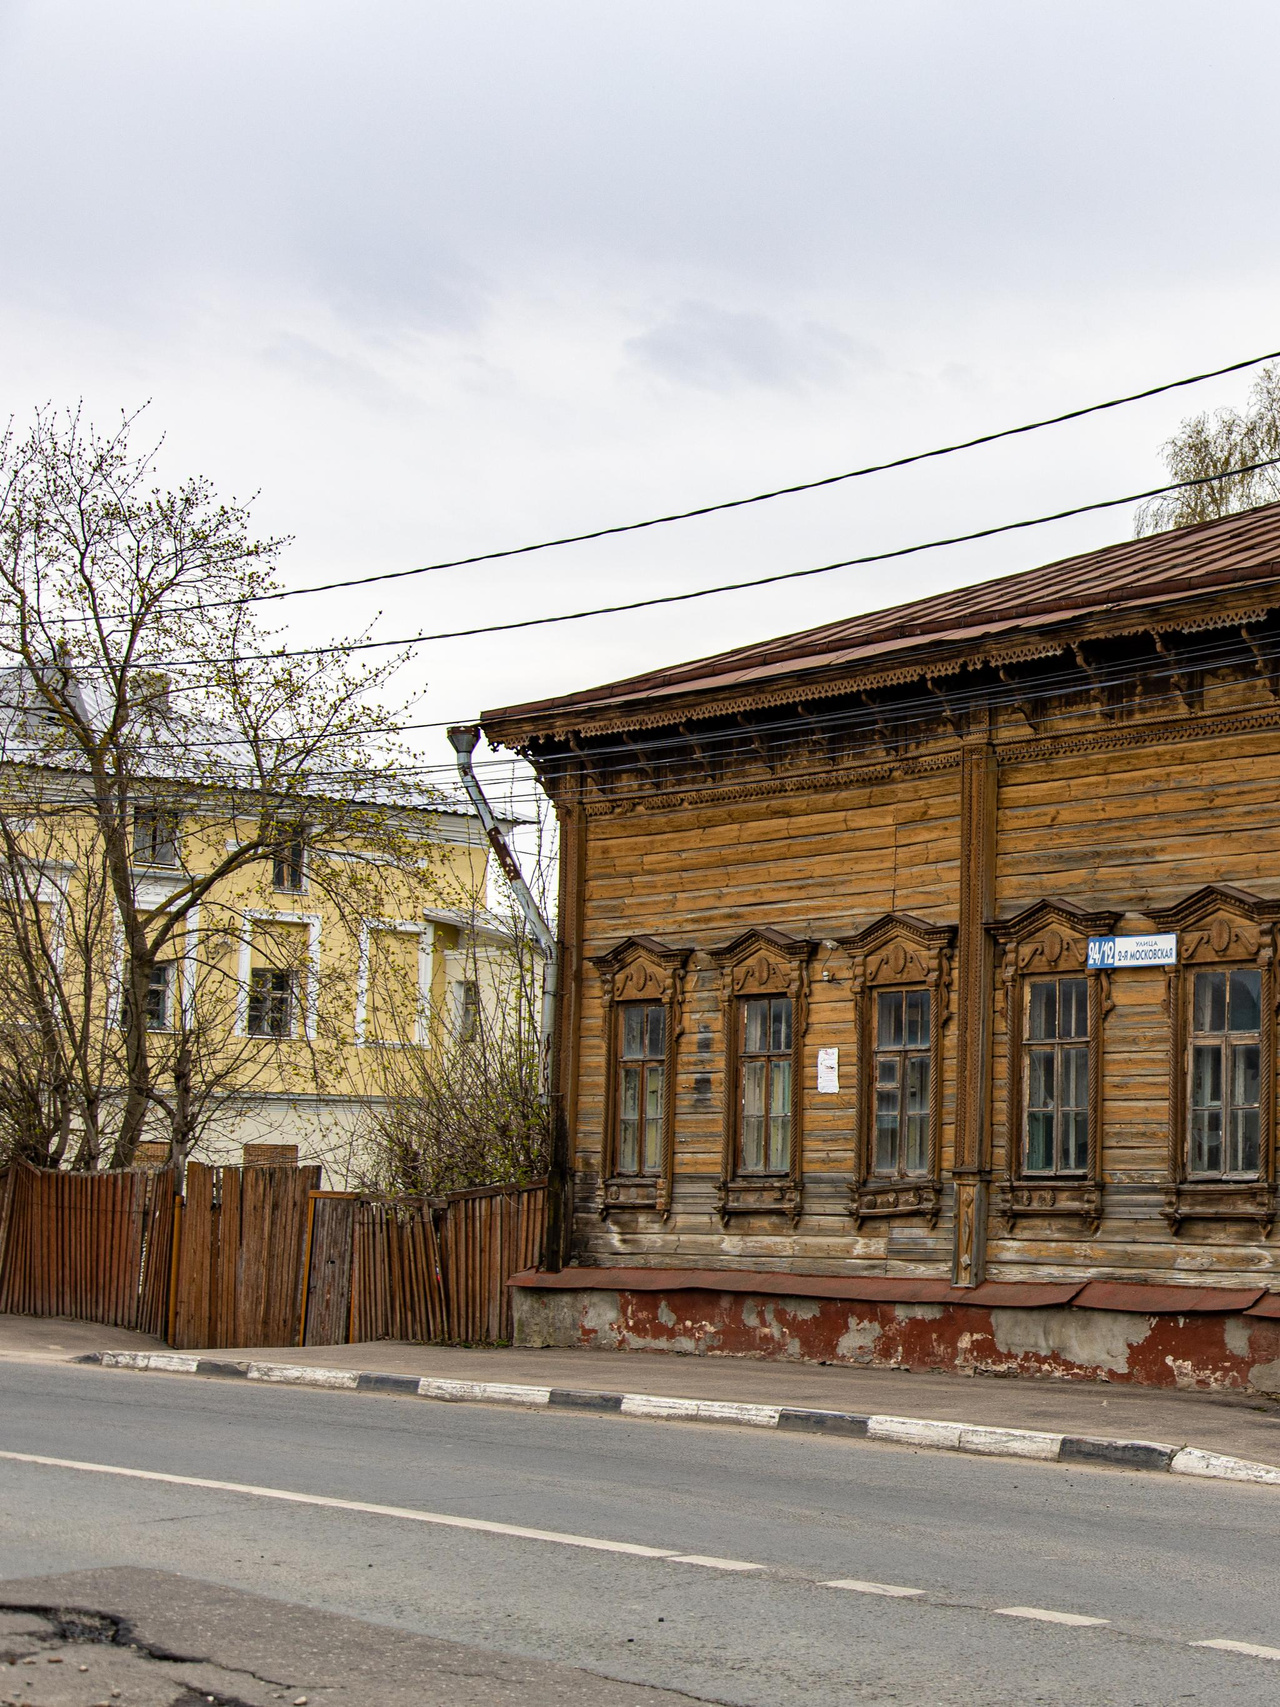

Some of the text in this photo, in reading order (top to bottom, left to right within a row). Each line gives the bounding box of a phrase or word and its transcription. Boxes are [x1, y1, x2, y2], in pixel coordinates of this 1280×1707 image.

[1088, 941, 1115, 965] 24/12
[1118, 948, 1173, 961] 2-Я МОСКОВСКАЯ
